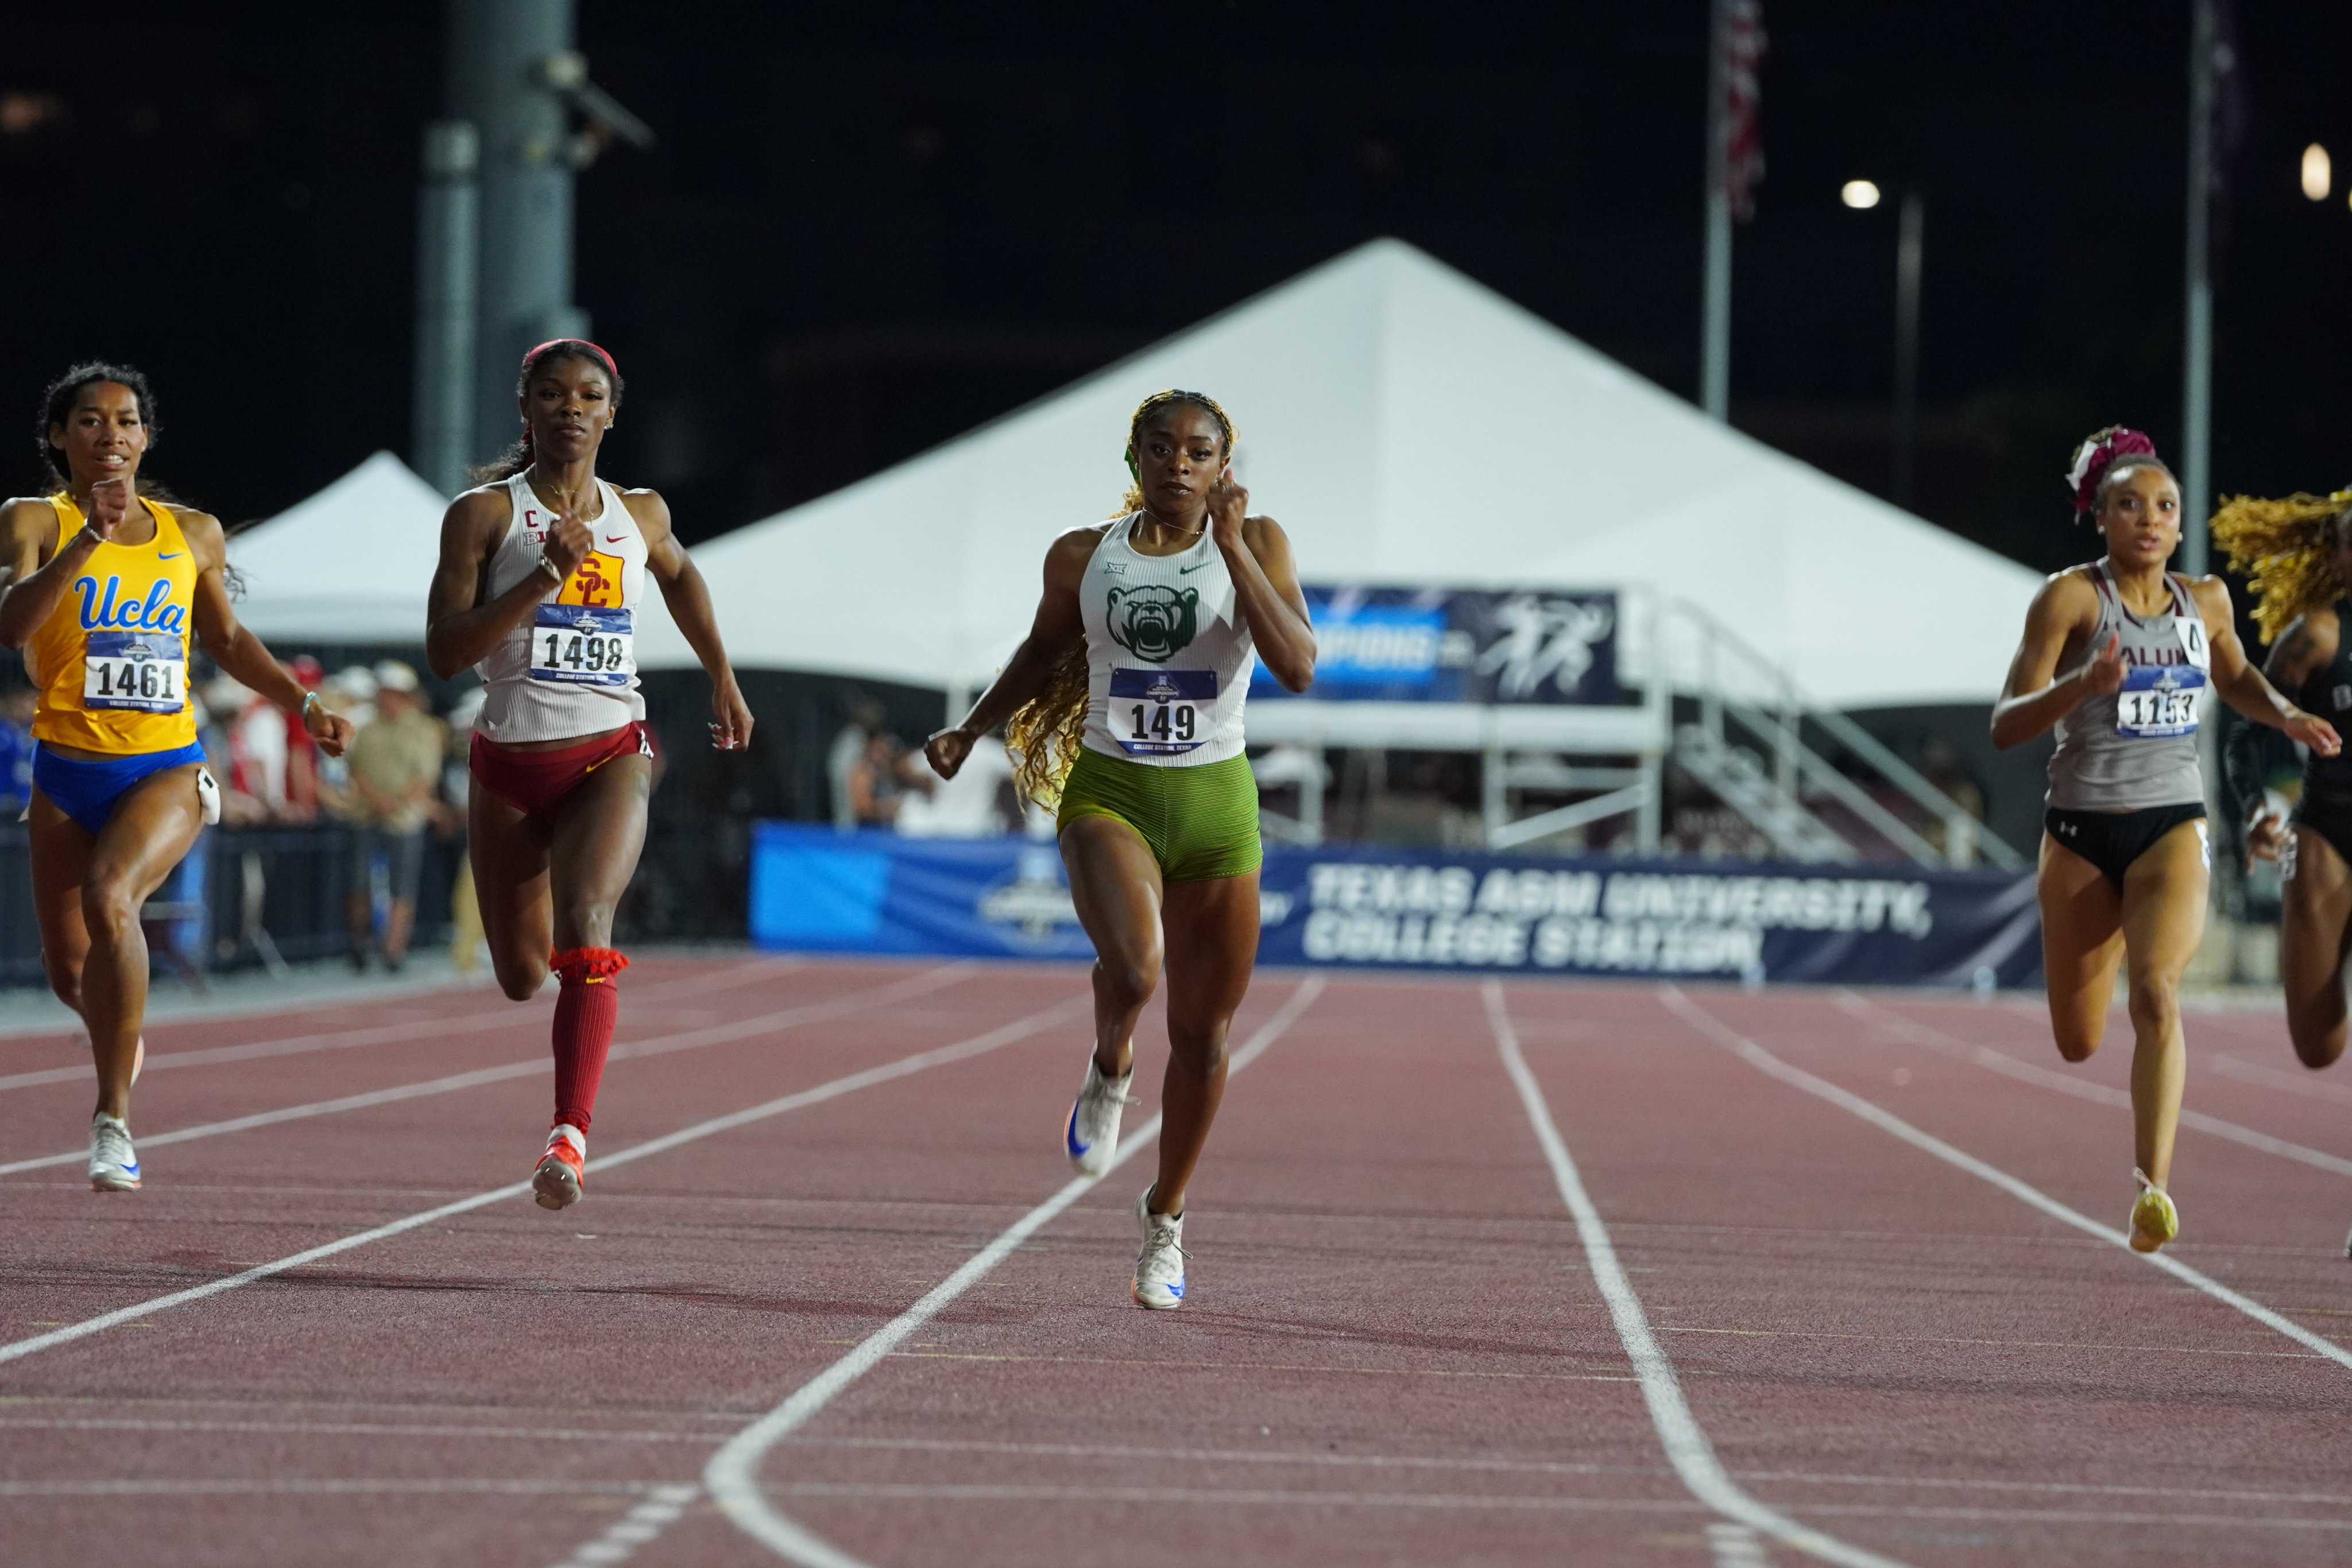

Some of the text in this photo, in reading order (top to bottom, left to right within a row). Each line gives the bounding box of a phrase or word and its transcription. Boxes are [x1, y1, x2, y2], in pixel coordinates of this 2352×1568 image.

[525, 510, 538, 527] C
[523, 531, 551, 545] B1
[544, 634, 622, 671] 1498
[98, 663, 174, 699] 1461
[1132, 704, 1194, 740] 149
[1307, 864, 1475, 914] TEXAS
[1303, 911, 1530, 966] COLLEGE
